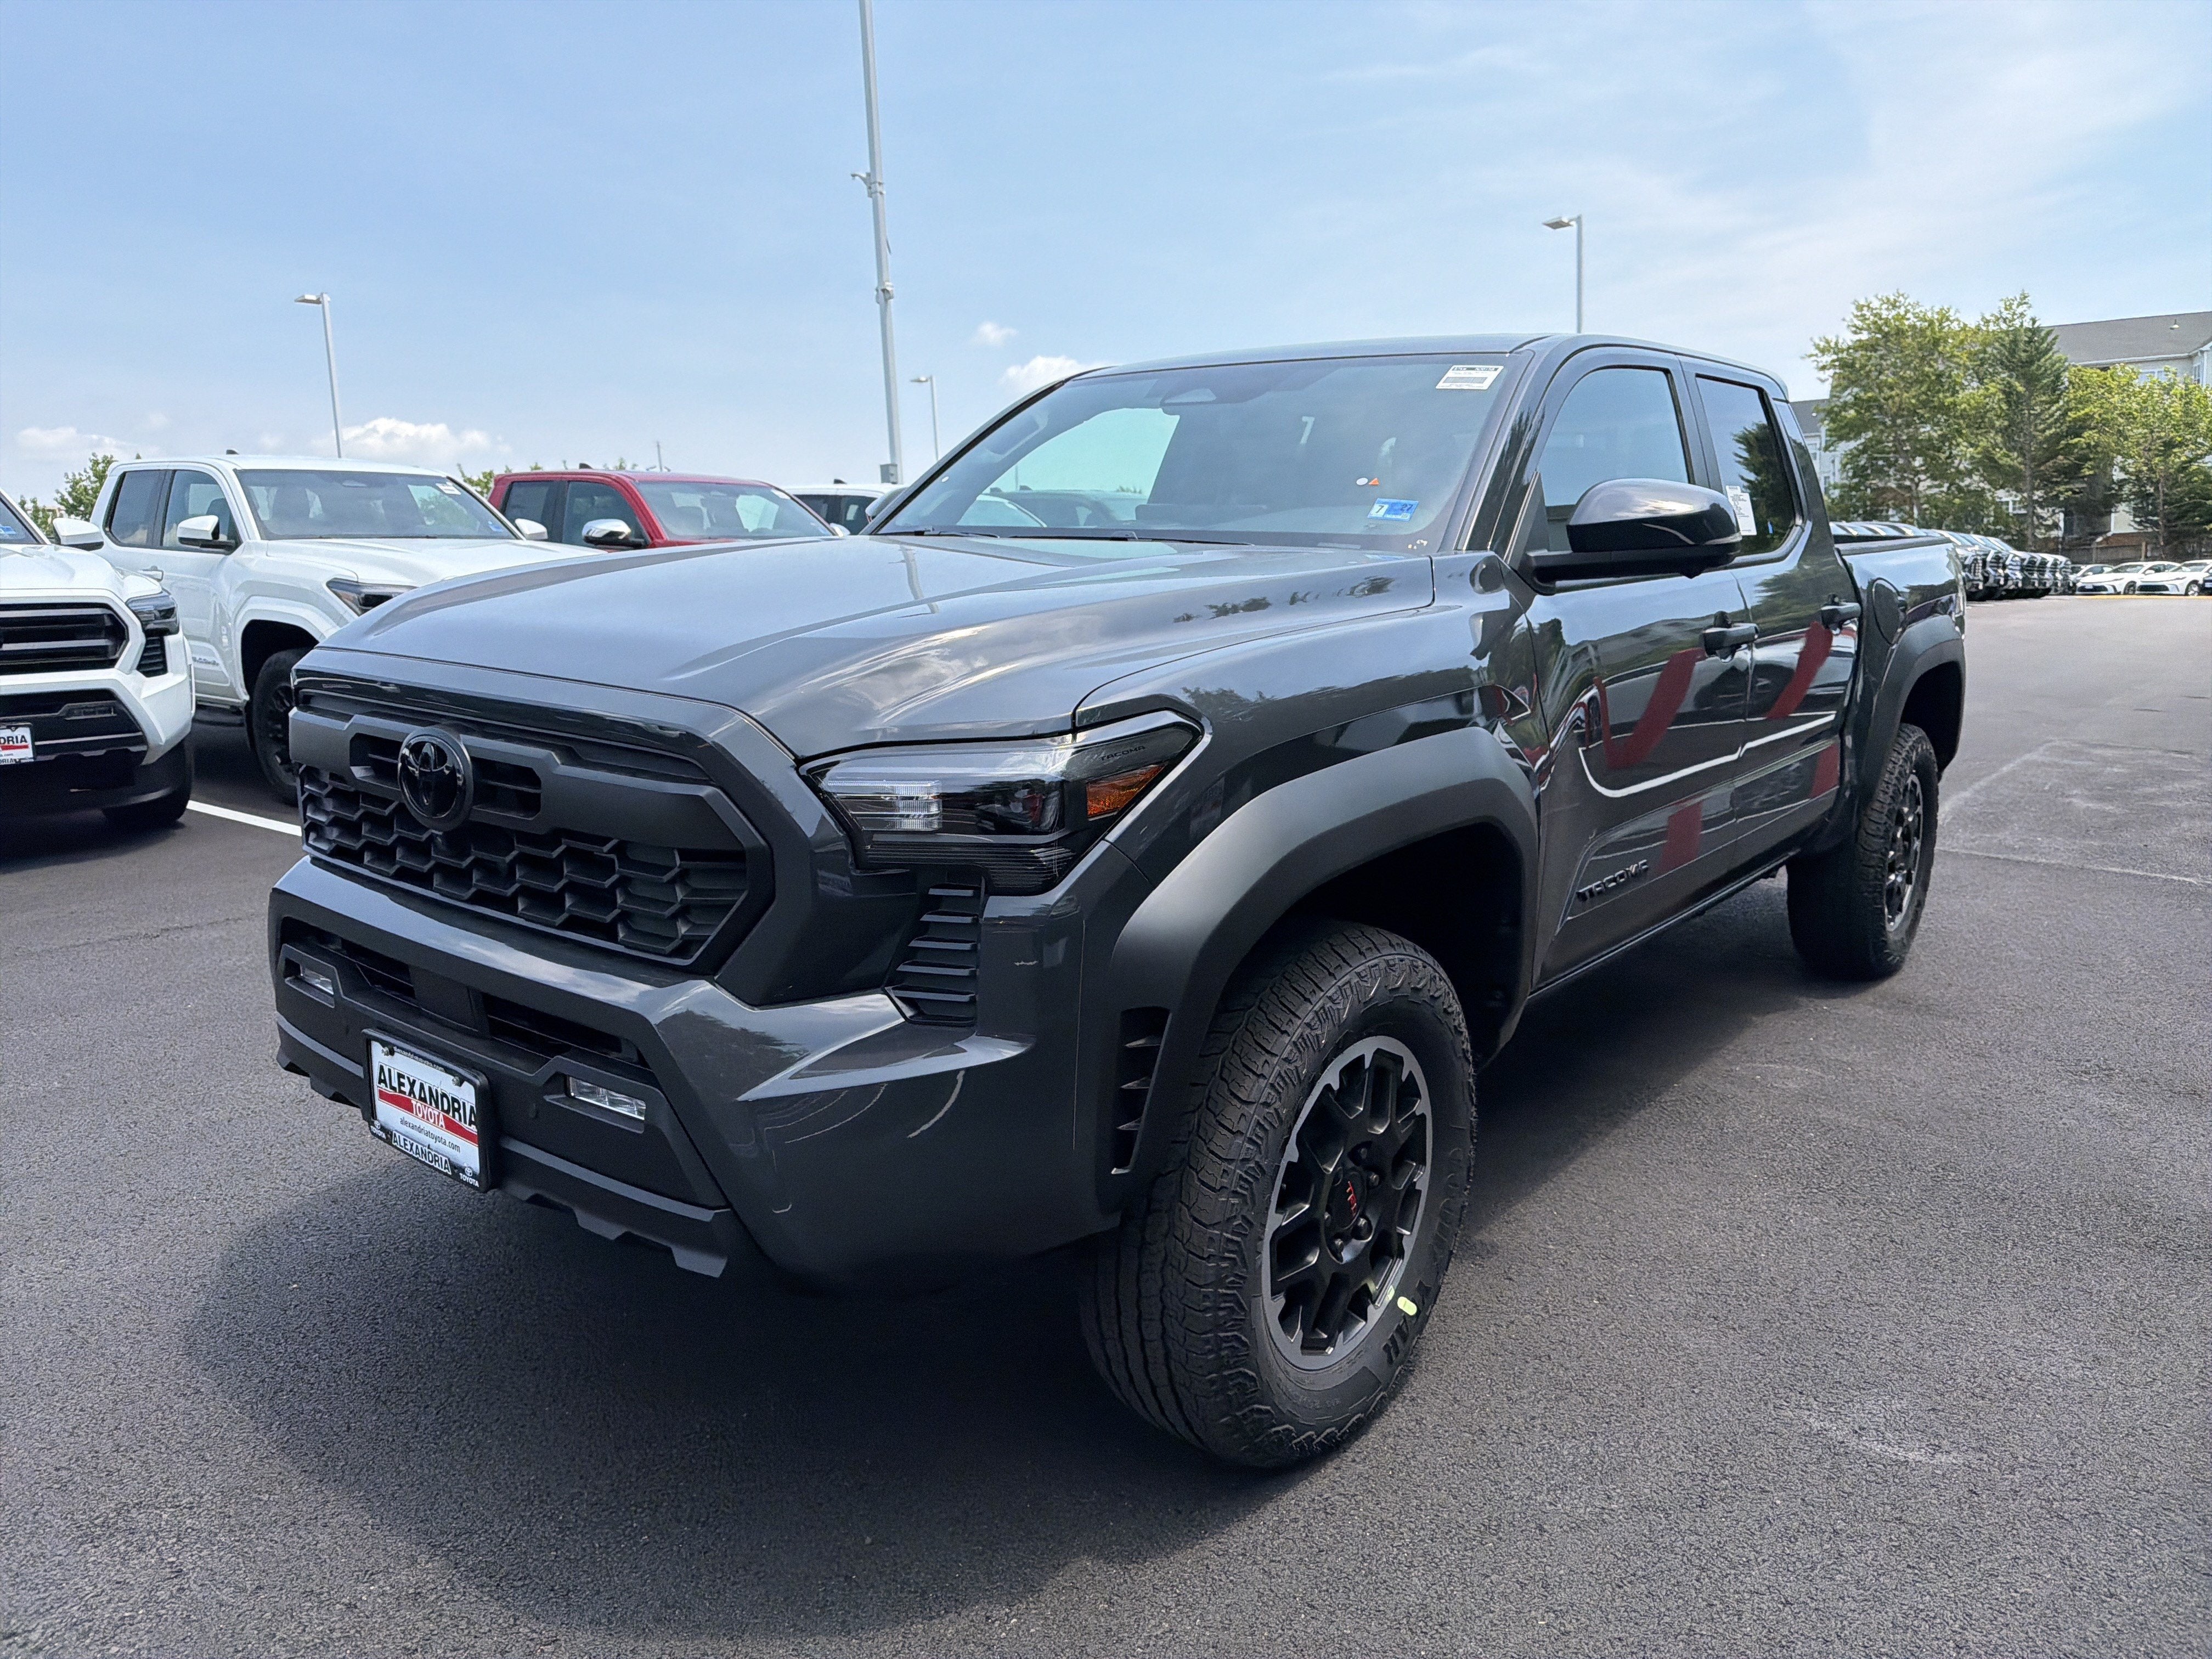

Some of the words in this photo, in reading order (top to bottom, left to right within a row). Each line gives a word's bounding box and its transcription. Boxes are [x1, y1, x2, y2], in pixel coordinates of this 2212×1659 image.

[1375, 505, 1385, 514] 7
[1400, 504, 1414, 512] 27
[1101, 746, 1145, 761] TACOMA
[377, 1064, 477, 1128] ALEXANDRIA
[411, 1101, 446, 1129] TOYOTA
[370, 1126, 386, 1139] TOYOTA
[400, 1116, 461, 1153] alexandriatoyota.com
[393, 1131, 451, 1174] ALEXANDRIA
[459, 1172, 479, 1188] TOYOTA
